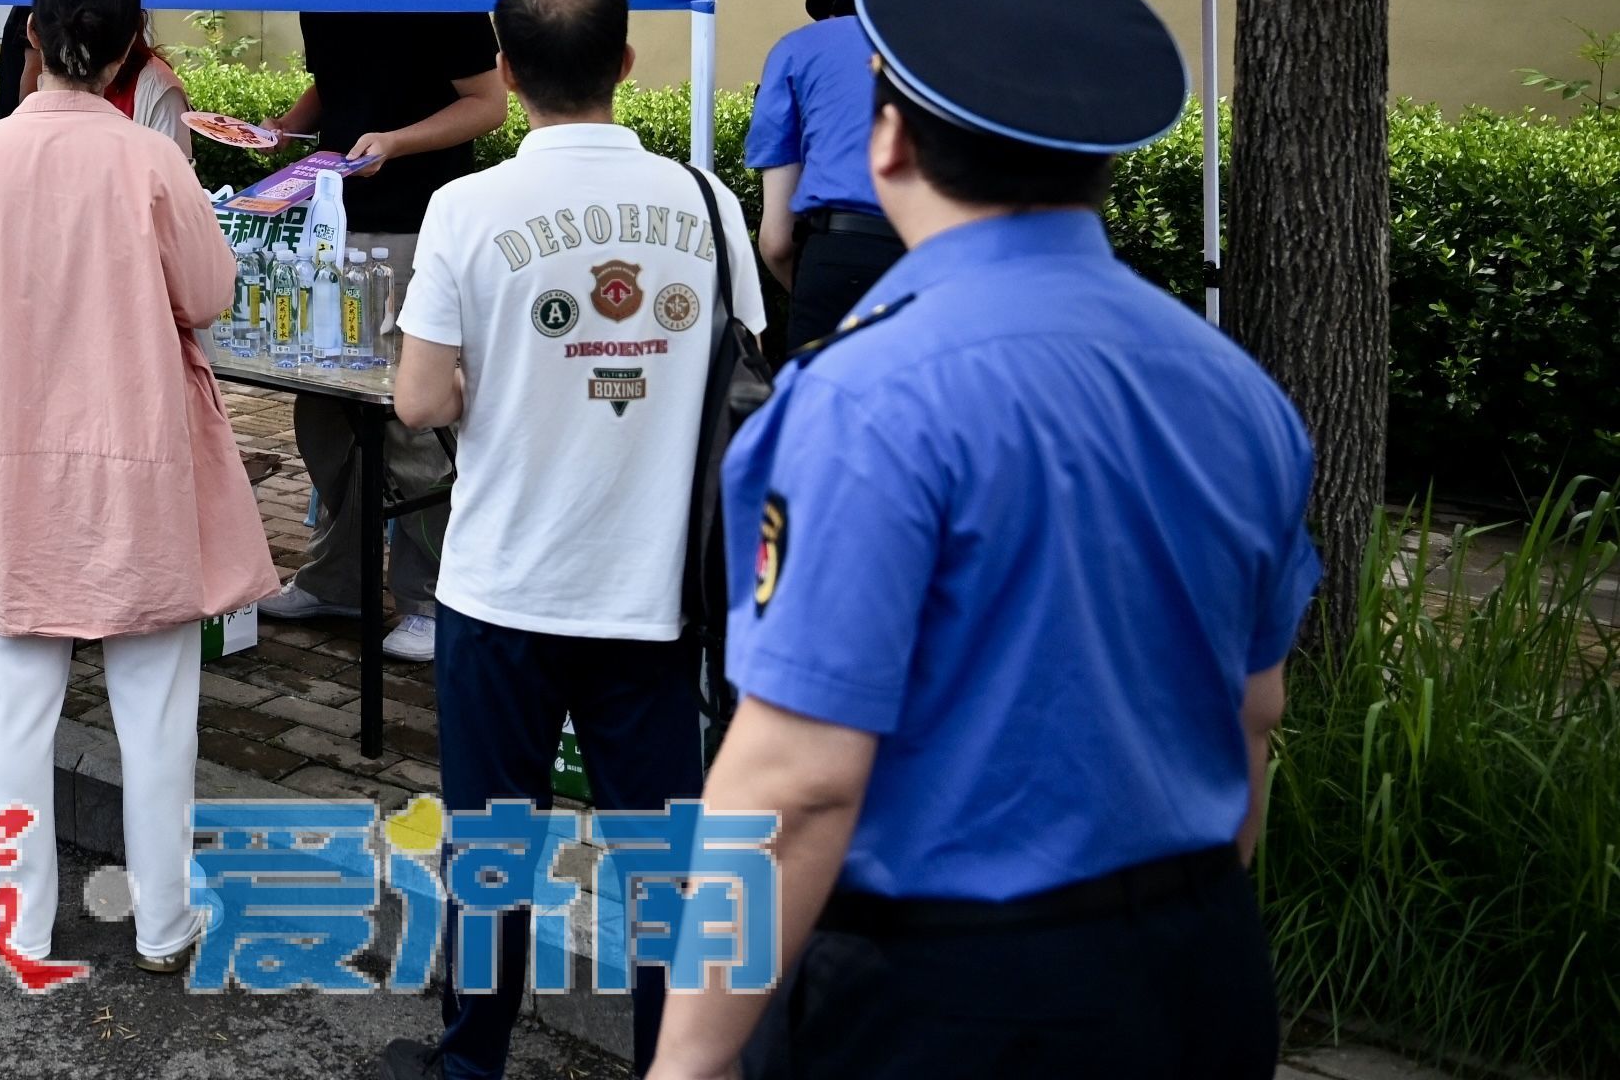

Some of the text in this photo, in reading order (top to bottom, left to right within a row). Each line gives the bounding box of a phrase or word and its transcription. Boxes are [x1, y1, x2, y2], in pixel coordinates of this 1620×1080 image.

[493, 203, 715, 272] DESOENTE
[279, 298, 288, 339] 天然矿泉水
[546, 301, 566, 324] A
[594, 381, 643, 398] BOXING
